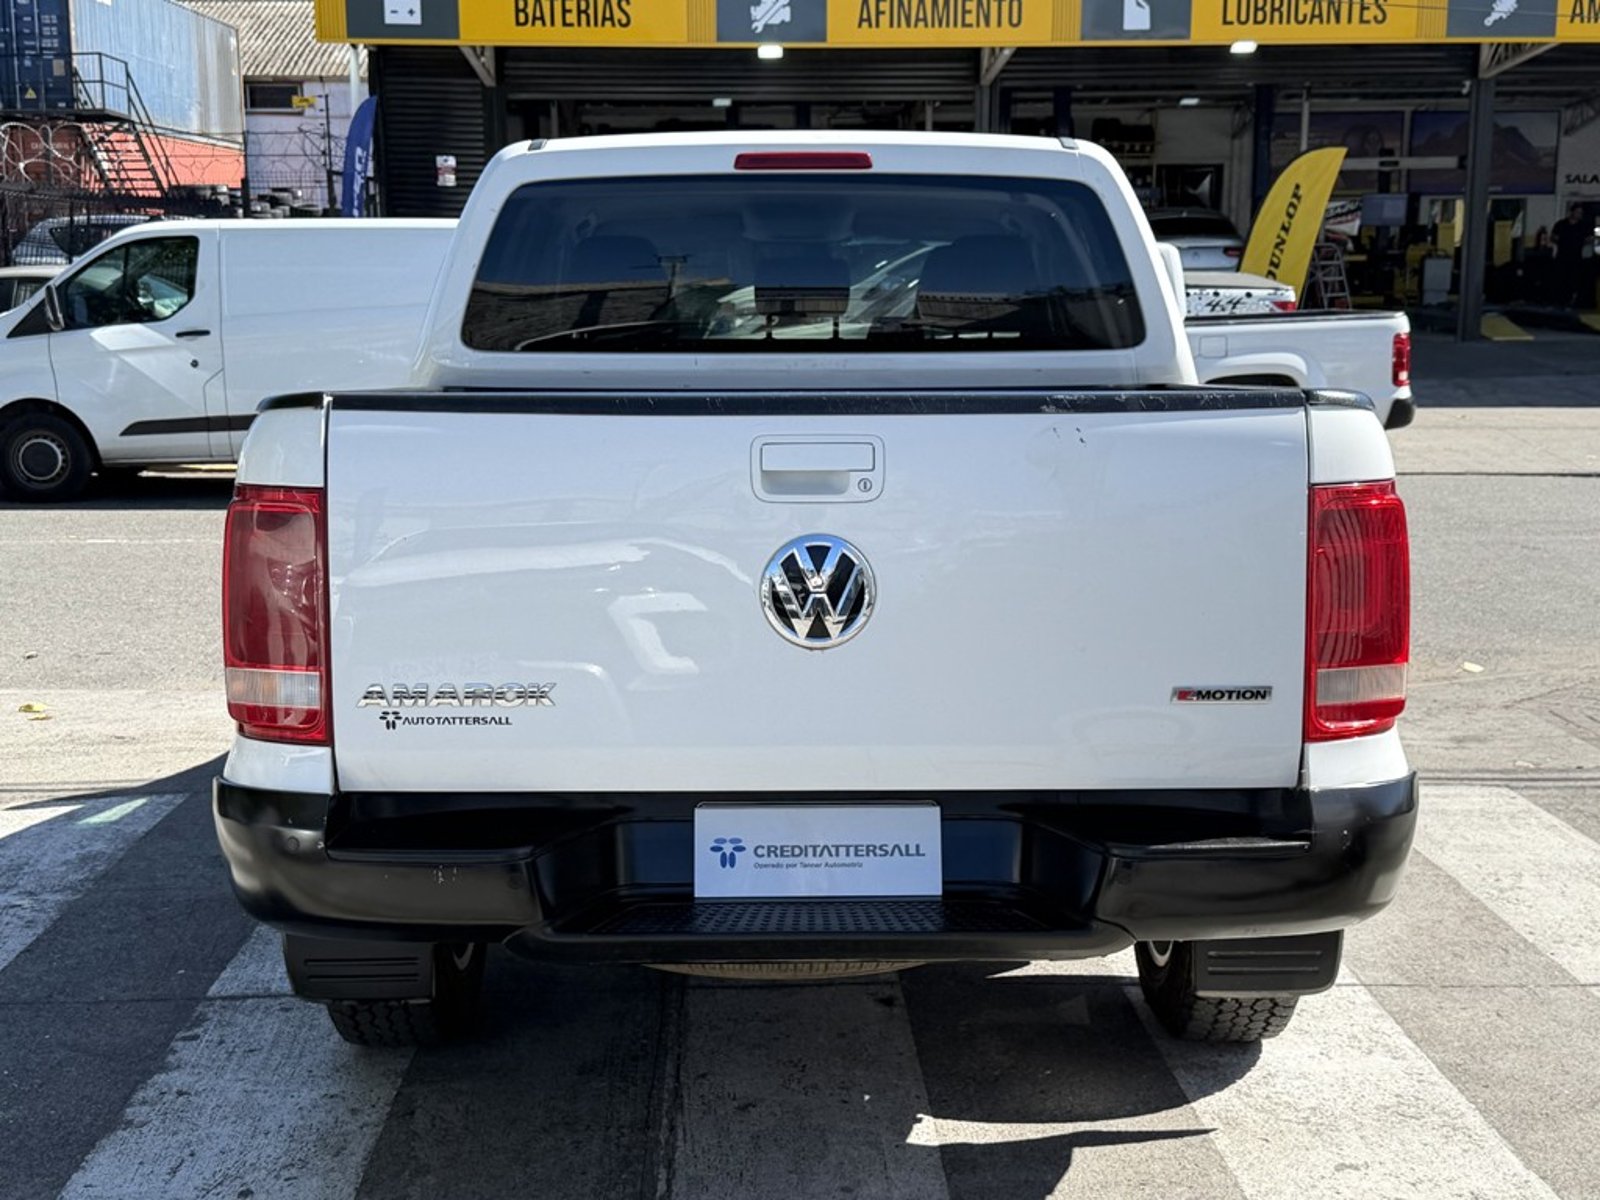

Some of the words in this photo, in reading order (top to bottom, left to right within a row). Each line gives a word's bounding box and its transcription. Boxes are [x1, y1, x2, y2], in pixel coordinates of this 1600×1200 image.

[515, 0, 631, 28] BATERIAS
[857, 0, 1023, 28] AFINAMIENTO
[1222, 0, 1388, 25] LUBRICANTES
[356, 682, 557, 708] AMAROK
[402, 716, 513, 726] AUTOTATTERSALL
[754, 843, 926, 858] CREDITATTERSALL
